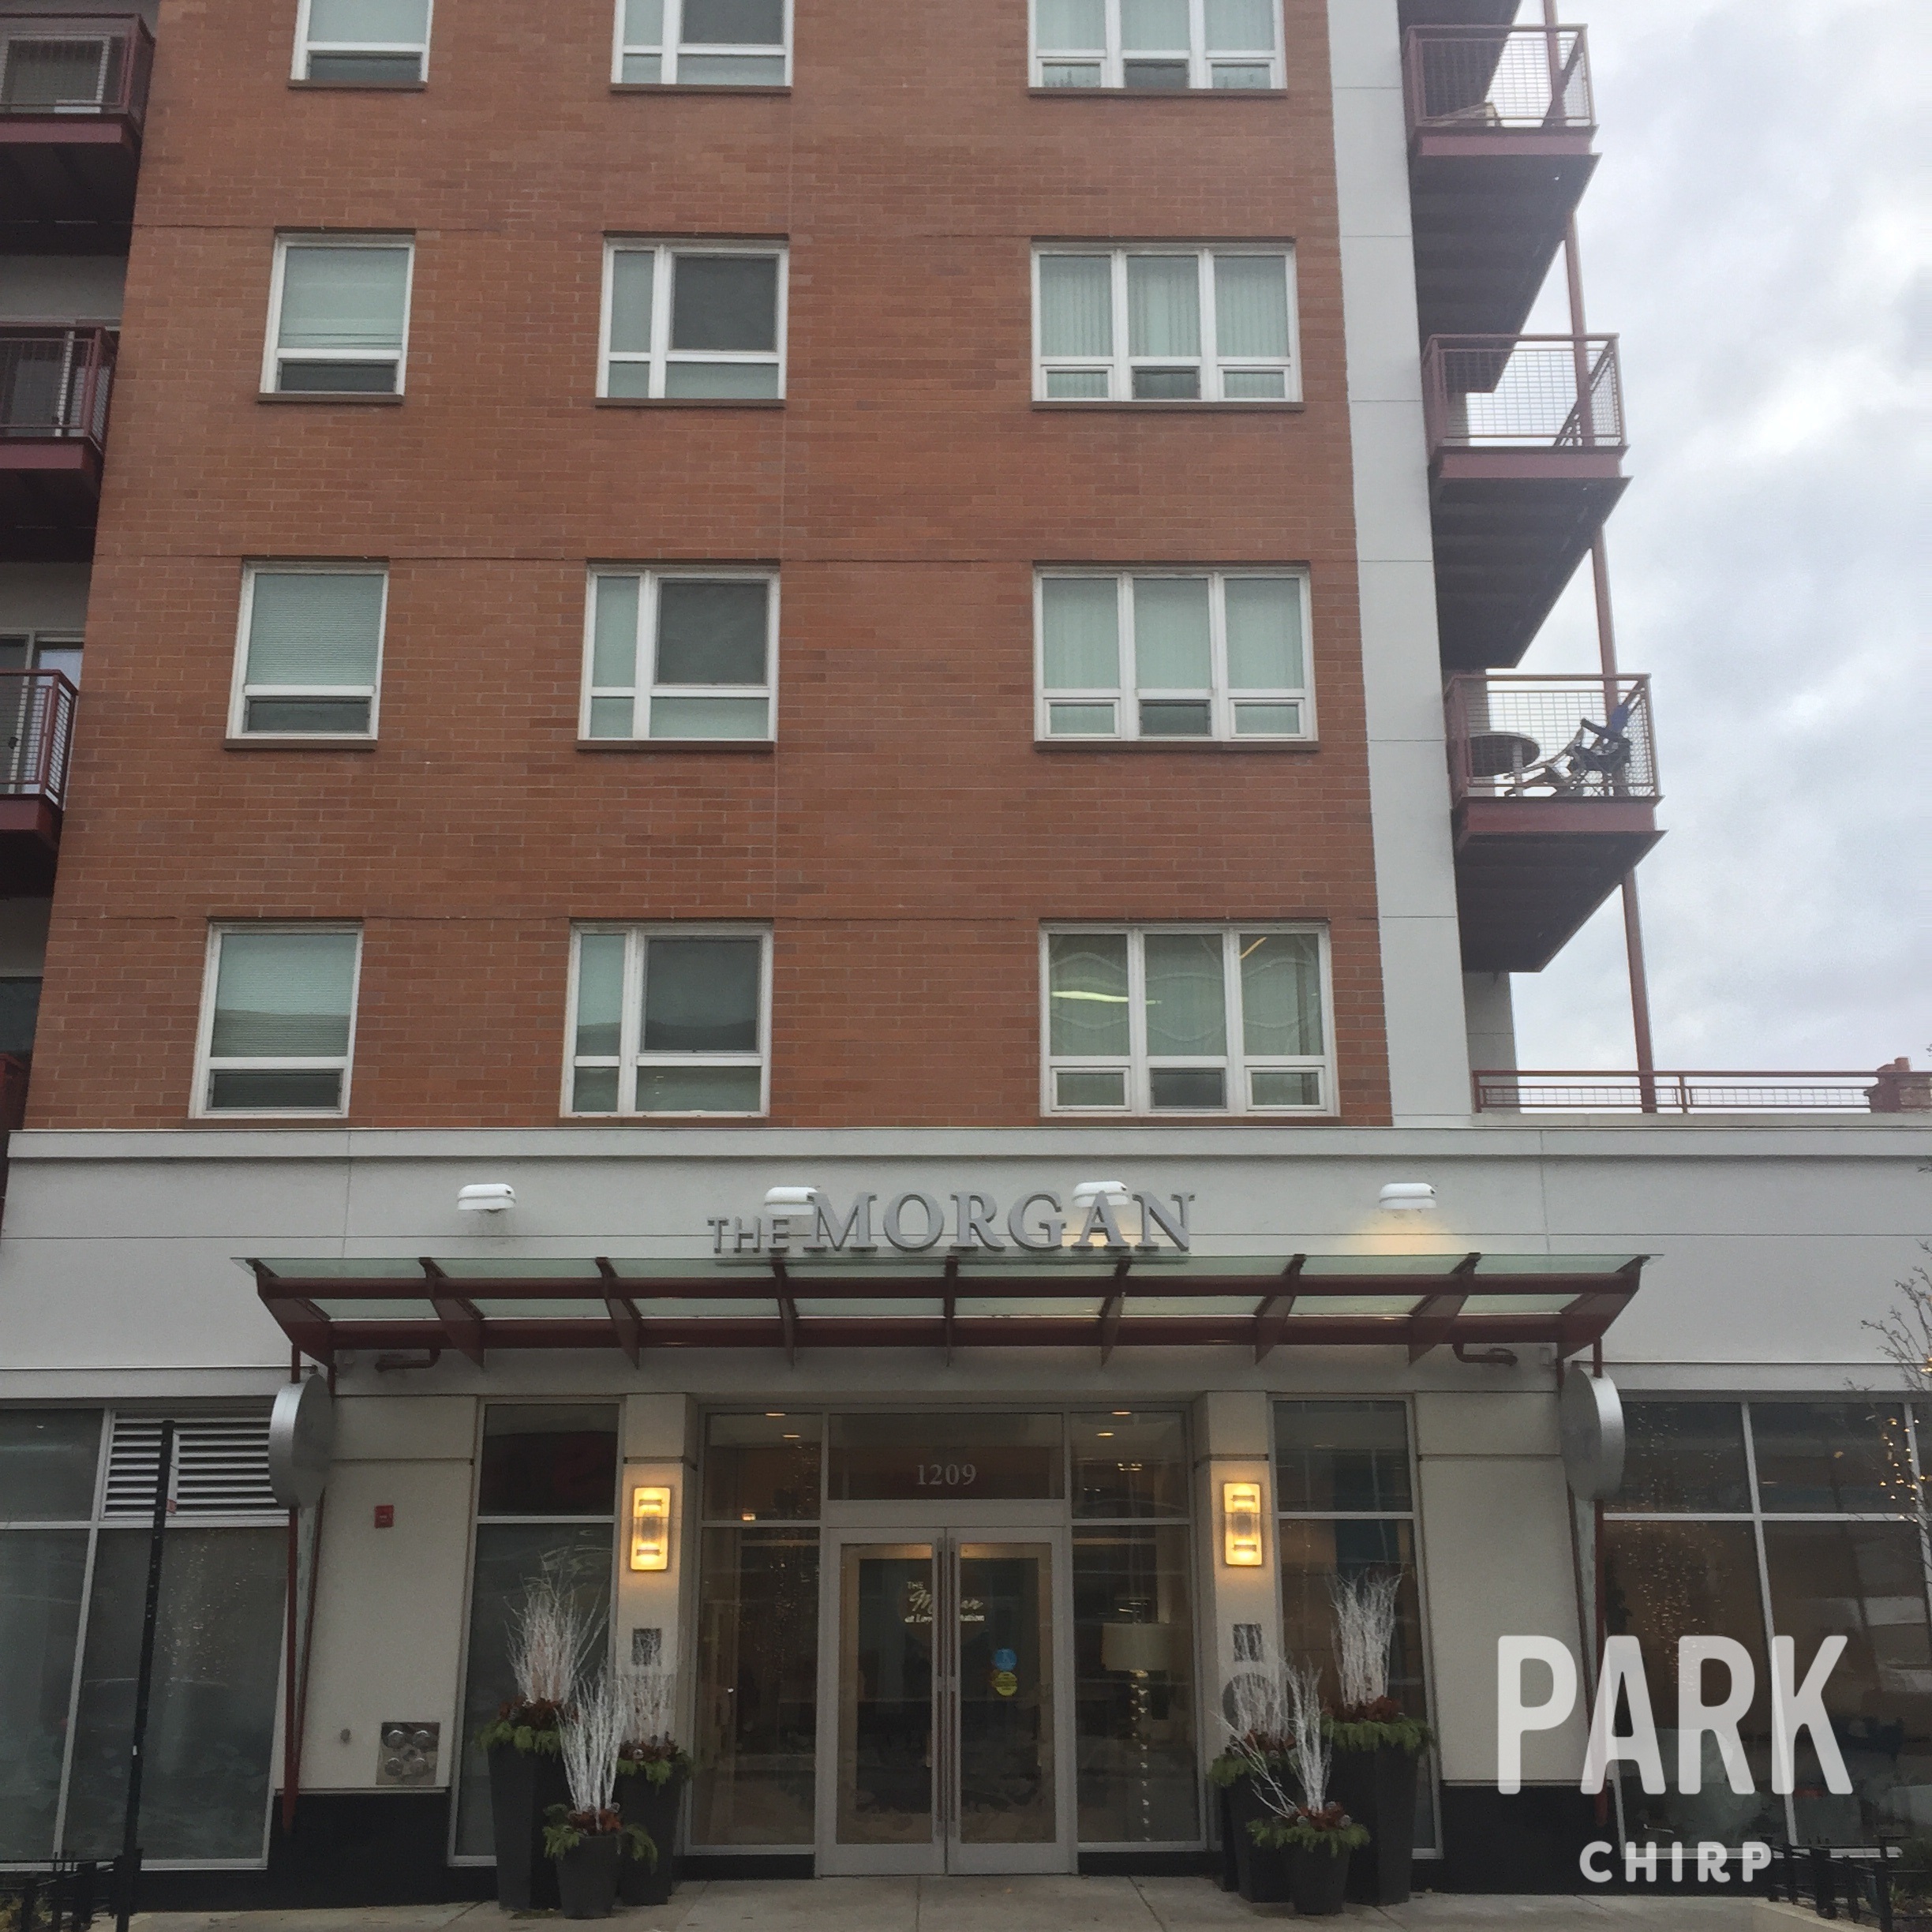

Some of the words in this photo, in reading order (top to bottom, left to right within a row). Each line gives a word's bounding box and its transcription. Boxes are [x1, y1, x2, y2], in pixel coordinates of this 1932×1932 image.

[706, 1216, 789, 1255] THE
[803, 1190, 1196, 1255] MORGAN
[916, 1463, 977, 1485] 1209
[907, 1581, 924, 1589] THE
